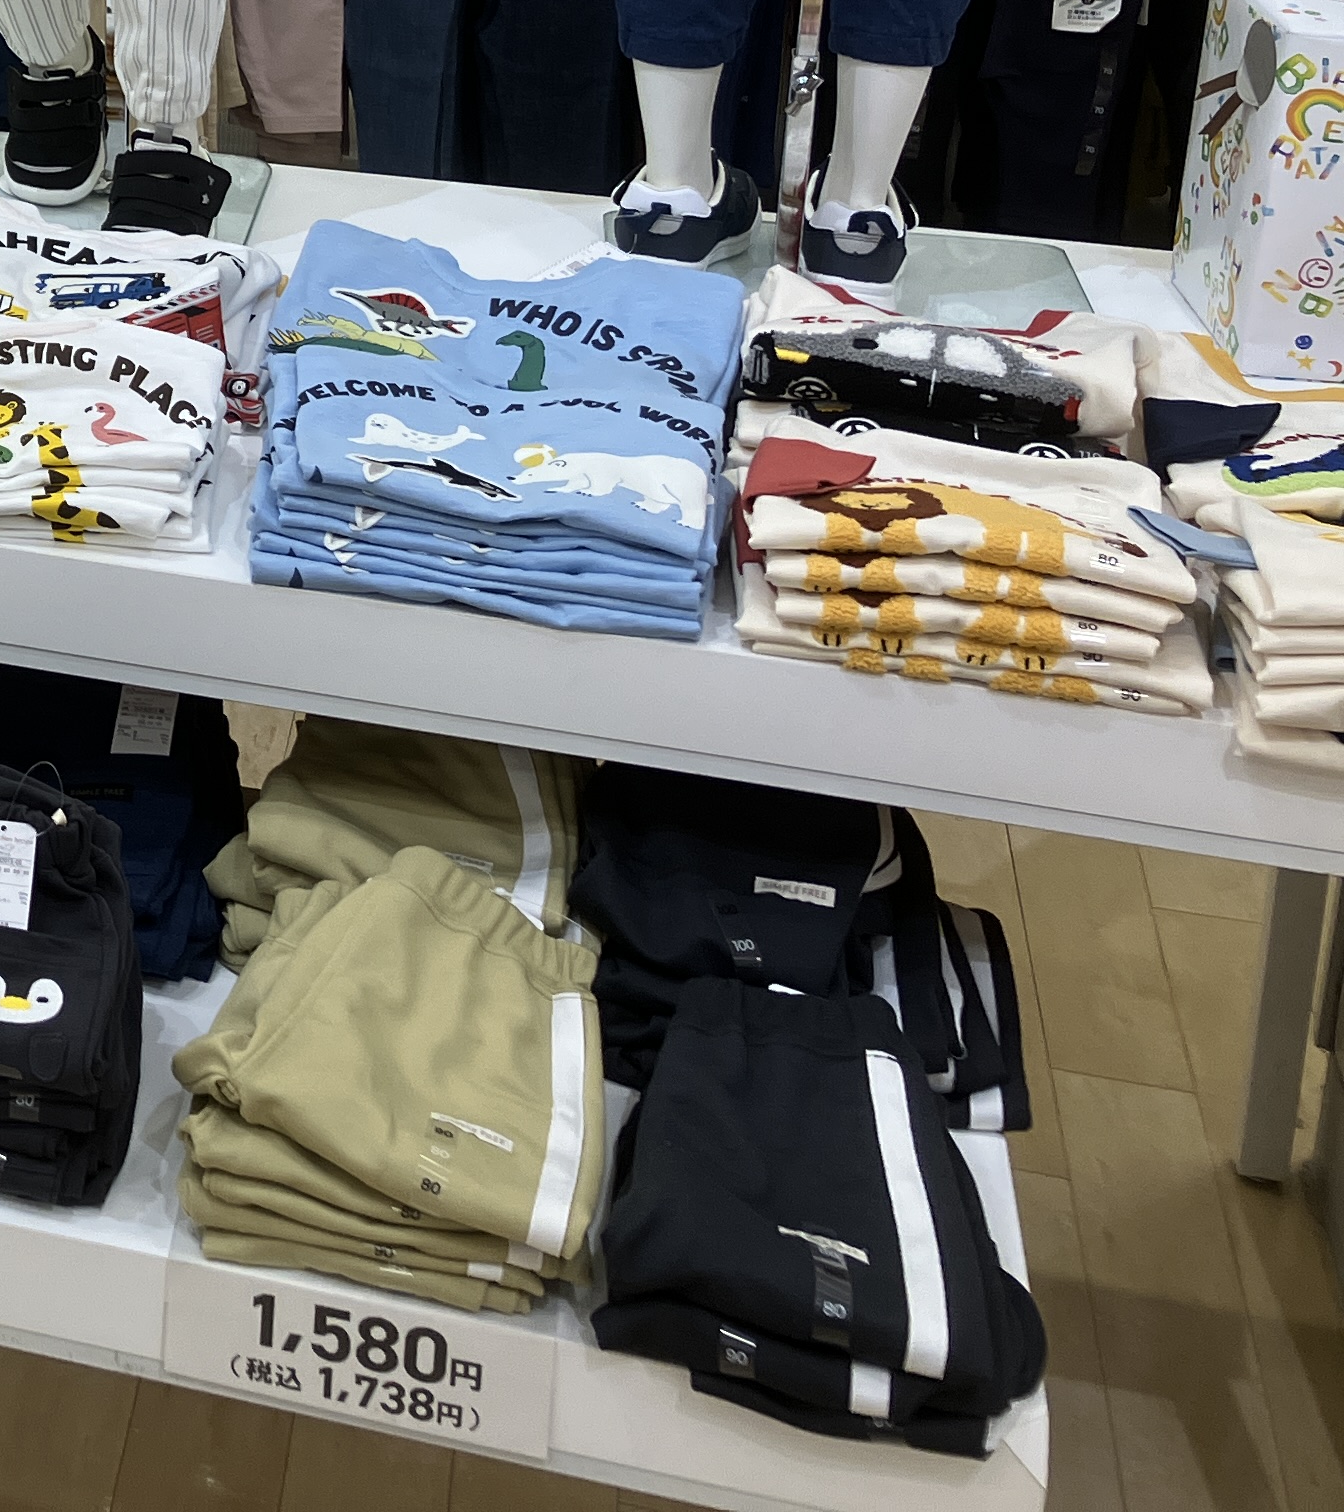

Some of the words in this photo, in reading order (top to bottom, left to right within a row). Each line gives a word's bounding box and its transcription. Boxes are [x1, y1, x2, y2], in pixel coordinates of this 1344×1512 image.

[489, 297, 584, 338] WHO
[584, 319, 624, 351] IS
[731, 937, 755, 954] 100
[421, 1178, 441, 1196] 80
[252, 1293, 483, 1394] 1,580円
